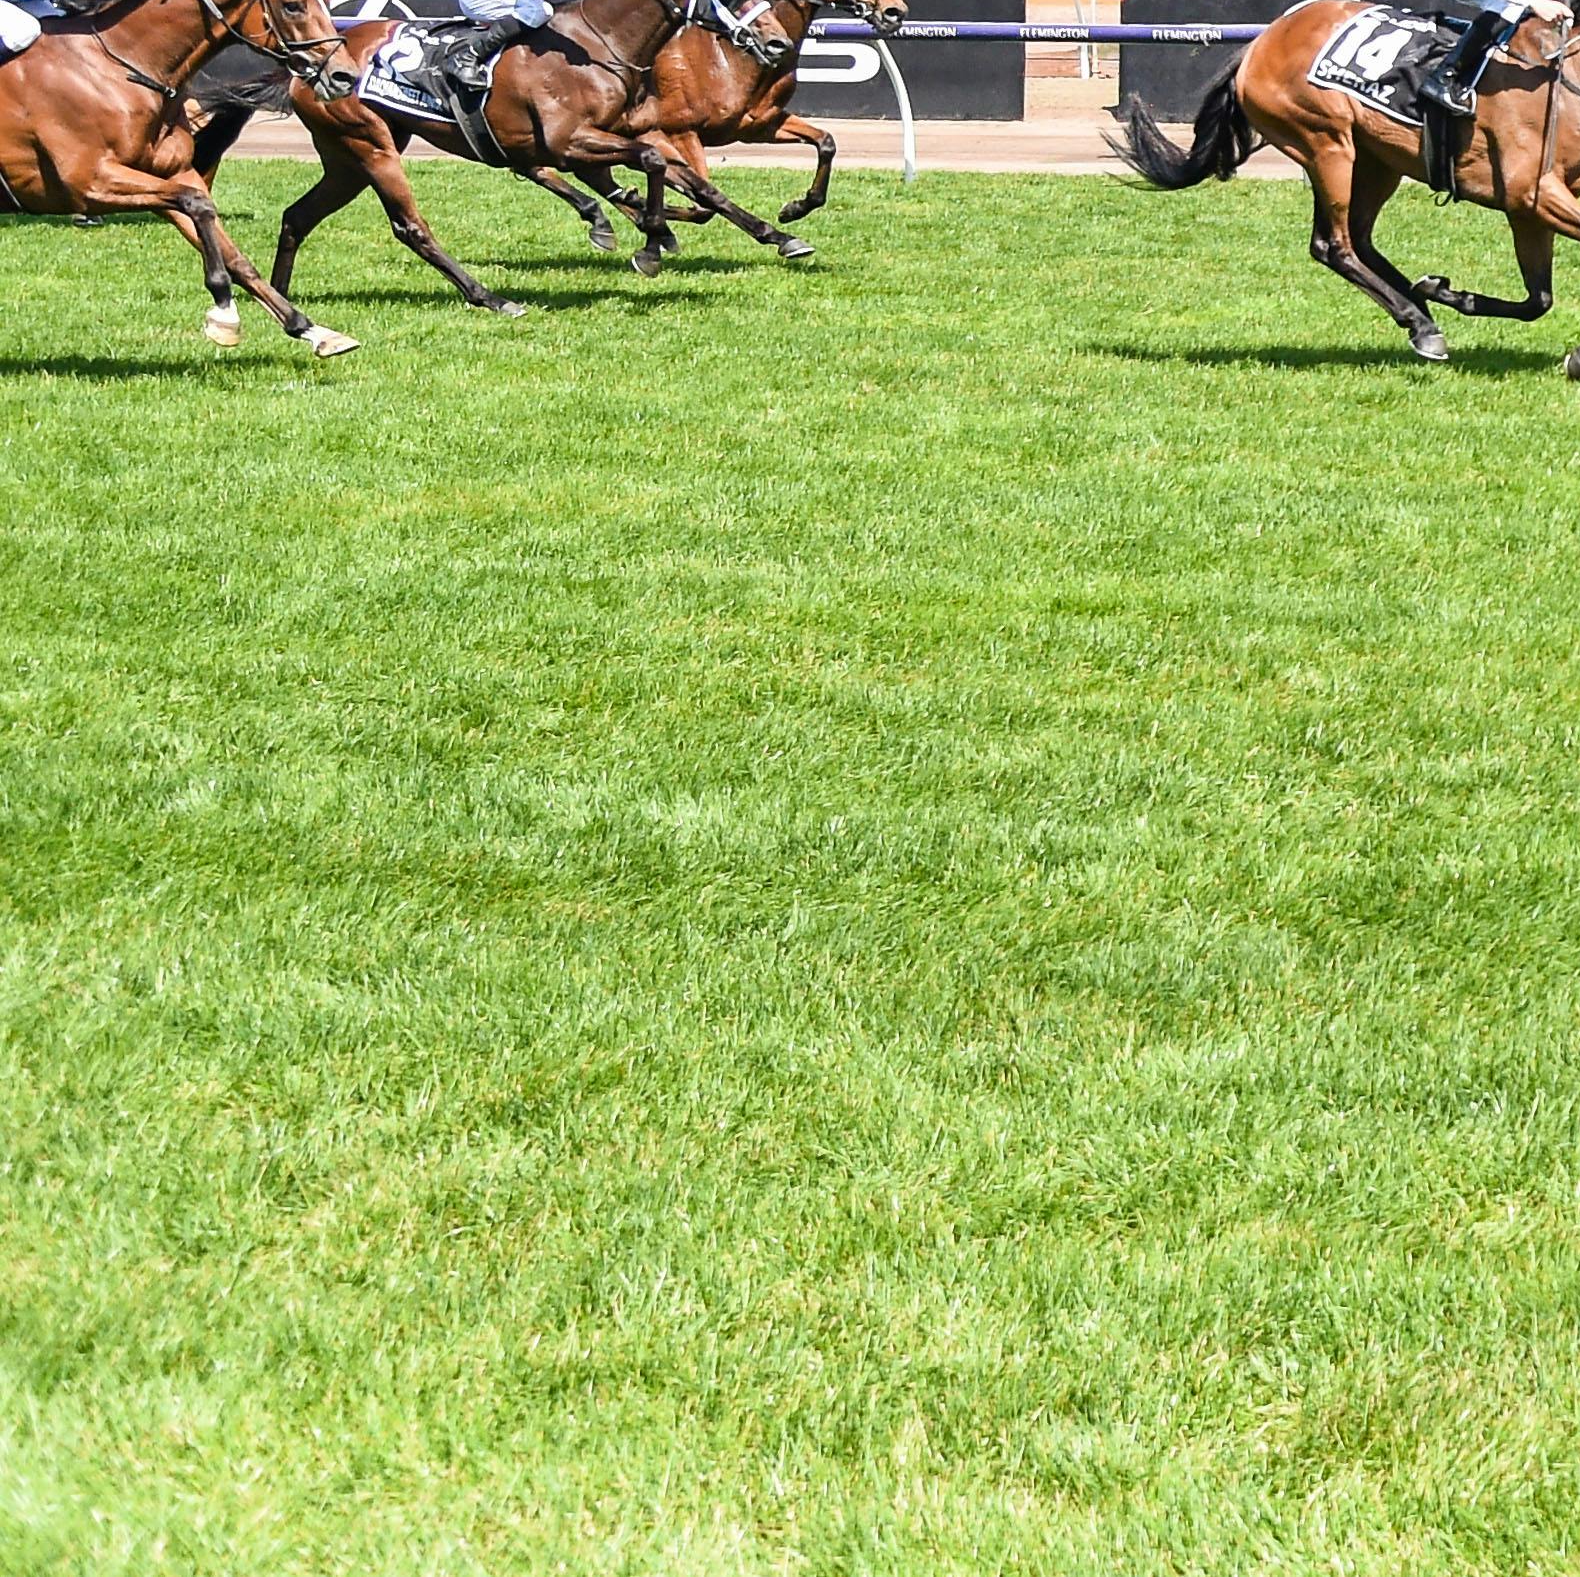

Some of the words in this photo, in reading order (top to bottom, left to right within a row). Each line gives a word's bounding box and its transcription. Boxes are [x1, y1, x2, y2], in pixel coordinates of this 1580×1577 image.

[1019, 28, 1090, 39] FLEMINGTON
[1151, 29, 1223, 40] FLEMINGTON
[1331, 15, 1412, 82] 14
